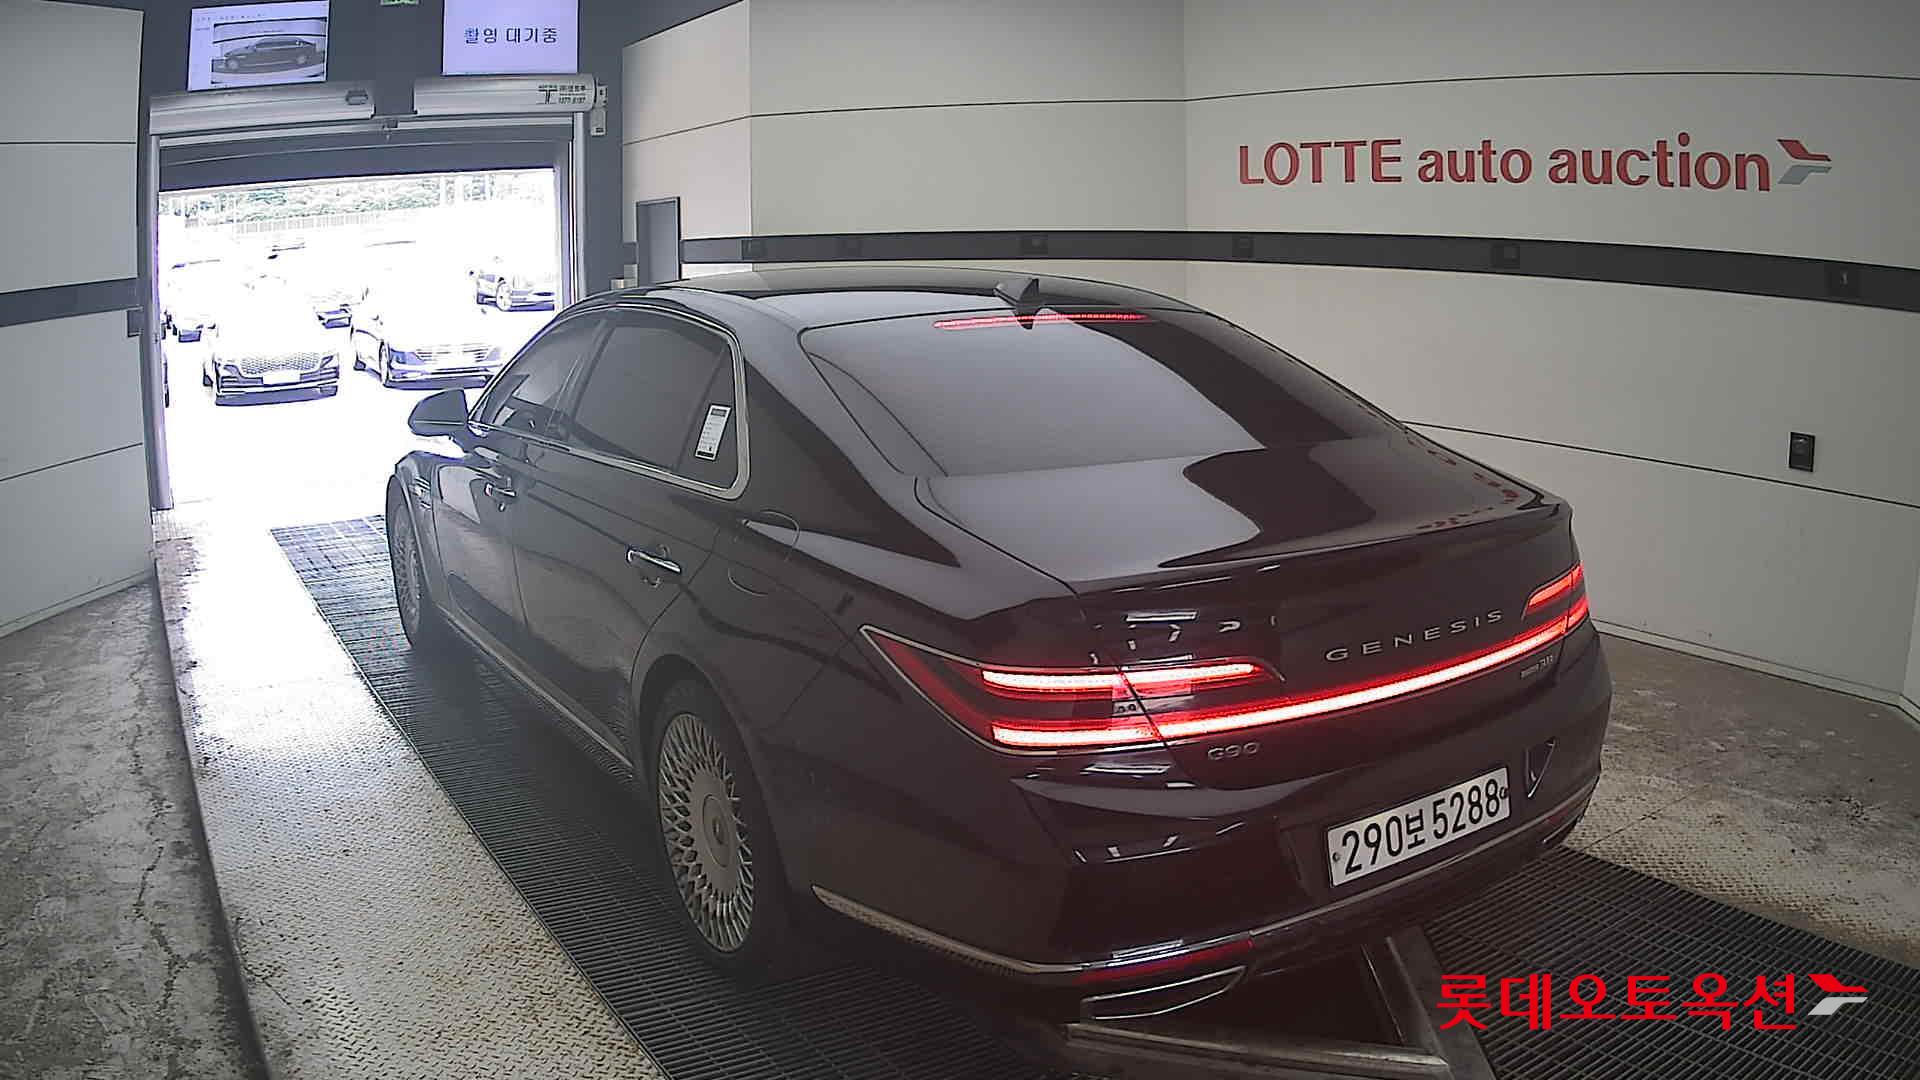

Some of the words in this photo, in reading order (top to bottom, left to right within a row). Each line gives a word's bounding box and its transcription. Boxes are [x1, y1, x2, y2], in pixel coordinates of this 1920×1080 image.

[506, 27, 558, 44] 대기중
[1239, 139, 1402, 185] LOTTE
[1417, 139, 1533, 182] auto
[1547, 132, 1771, 192] auction
[1326, 610, 1502, 661] GENESIS
[1207, 742, 1259, 760] G90
